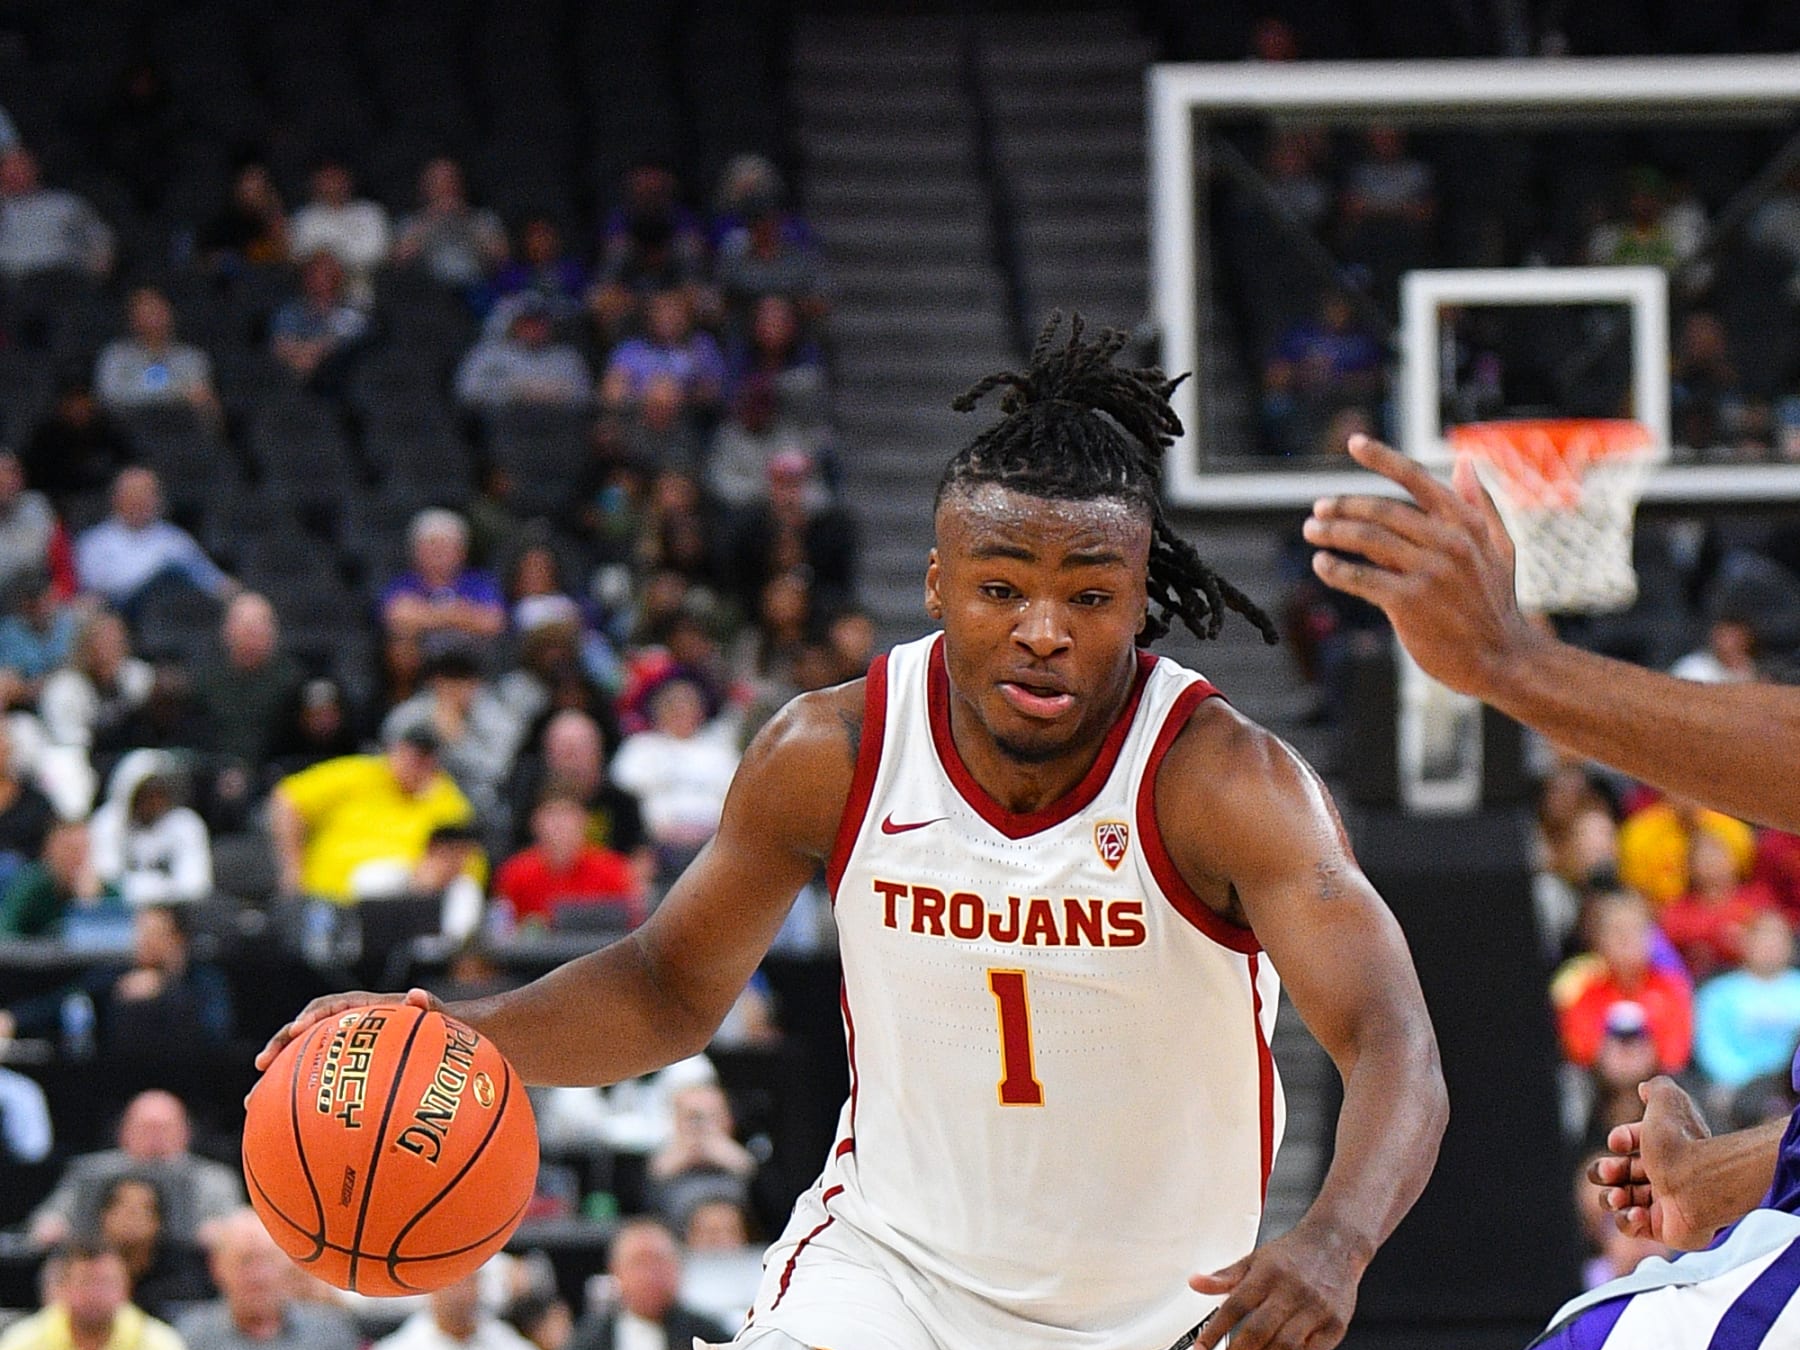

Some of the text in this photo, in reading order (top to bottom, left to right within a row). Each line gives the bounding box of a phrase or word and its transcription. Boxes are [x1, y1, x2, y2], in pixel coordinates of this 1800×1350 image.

[1097, 823, 1128, 851] PAC
[1103, 842, 1121, 860] 12
[873, 879, 1147, 948] TROJANS
[335, 1007, 397, 1129] LEGACY
[986, 967, 1045, 1107] 1
